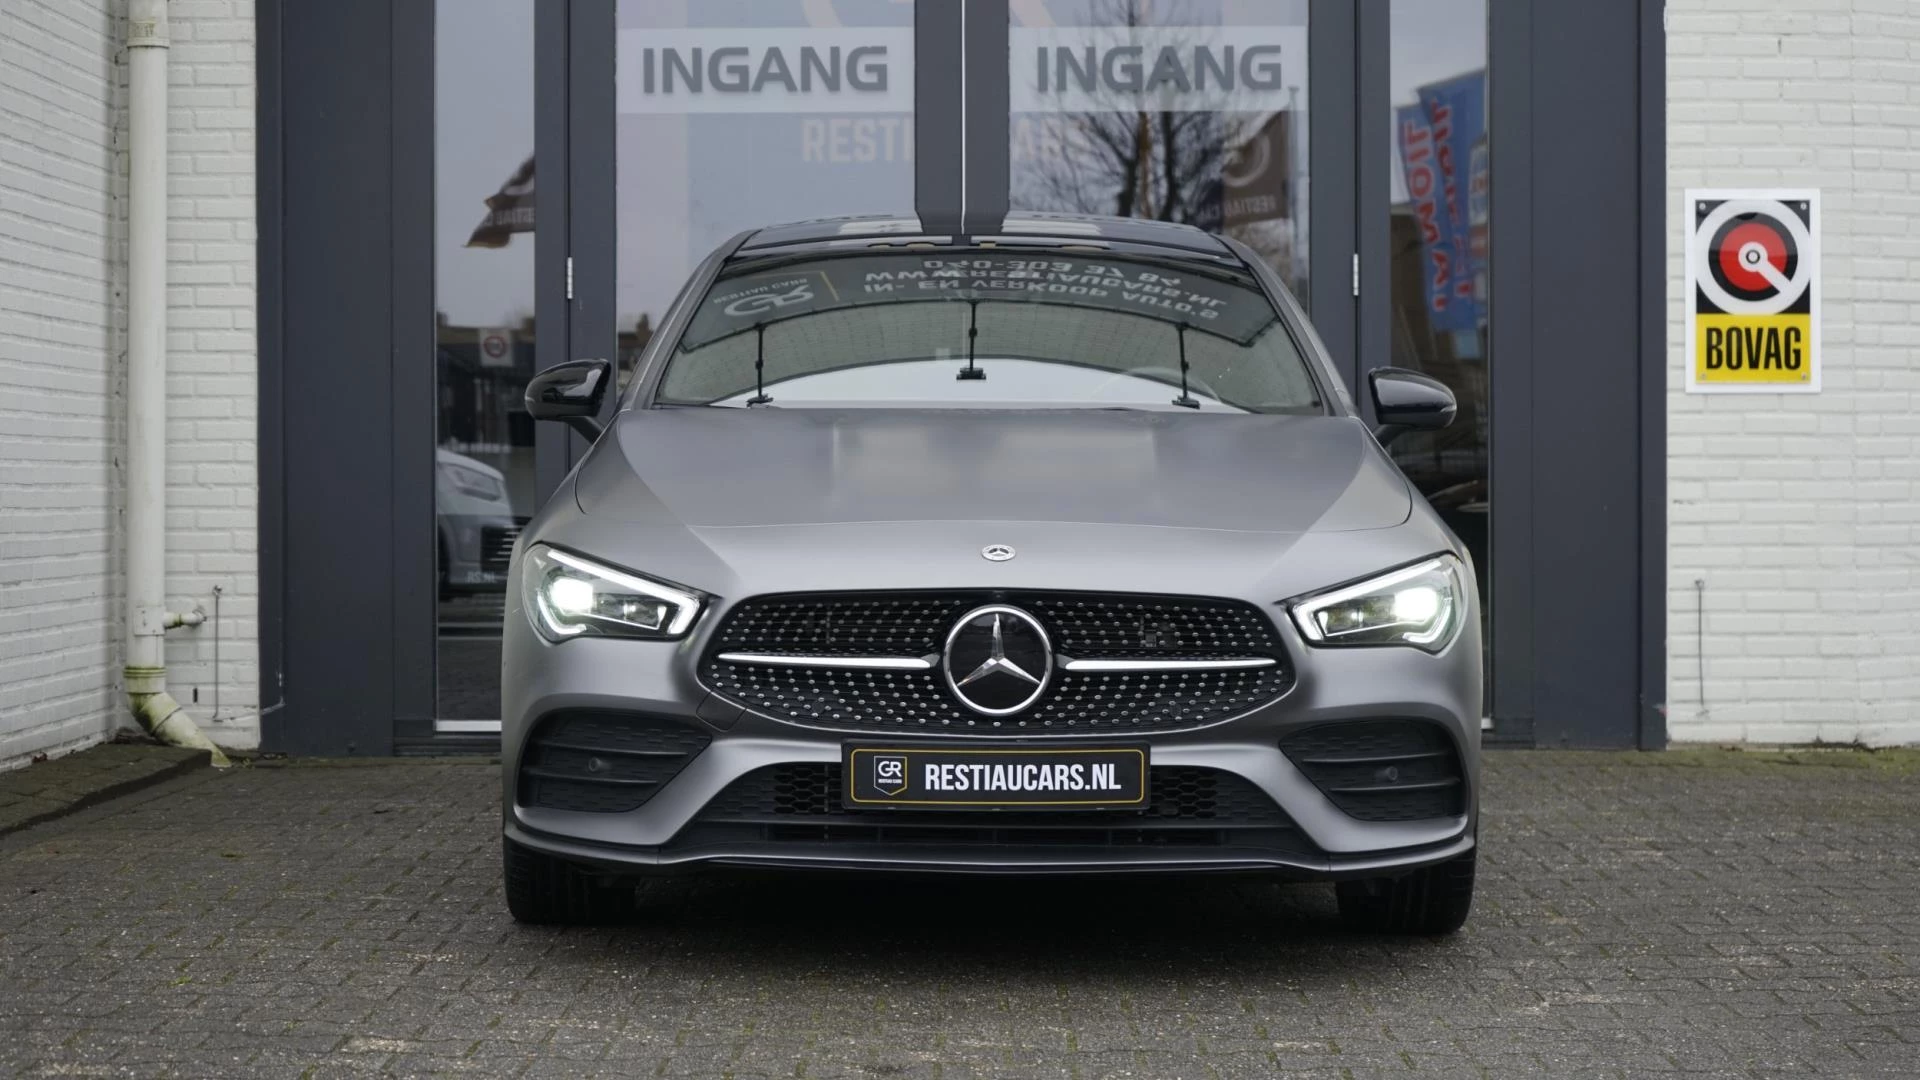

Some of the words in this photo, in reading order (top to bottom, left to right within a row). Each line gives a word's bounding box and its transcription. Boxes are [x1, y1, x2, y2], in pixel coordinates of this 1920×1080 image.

[642, 46, 888, 94] INGANG
[1036, 45, 1282, 93] INGANG
[801, 118, 914, 163] RESTI
[1705, 326, 1802, 371] BOVAG
[925, 764, 1121, 791] RESTIAUCARS.NL
